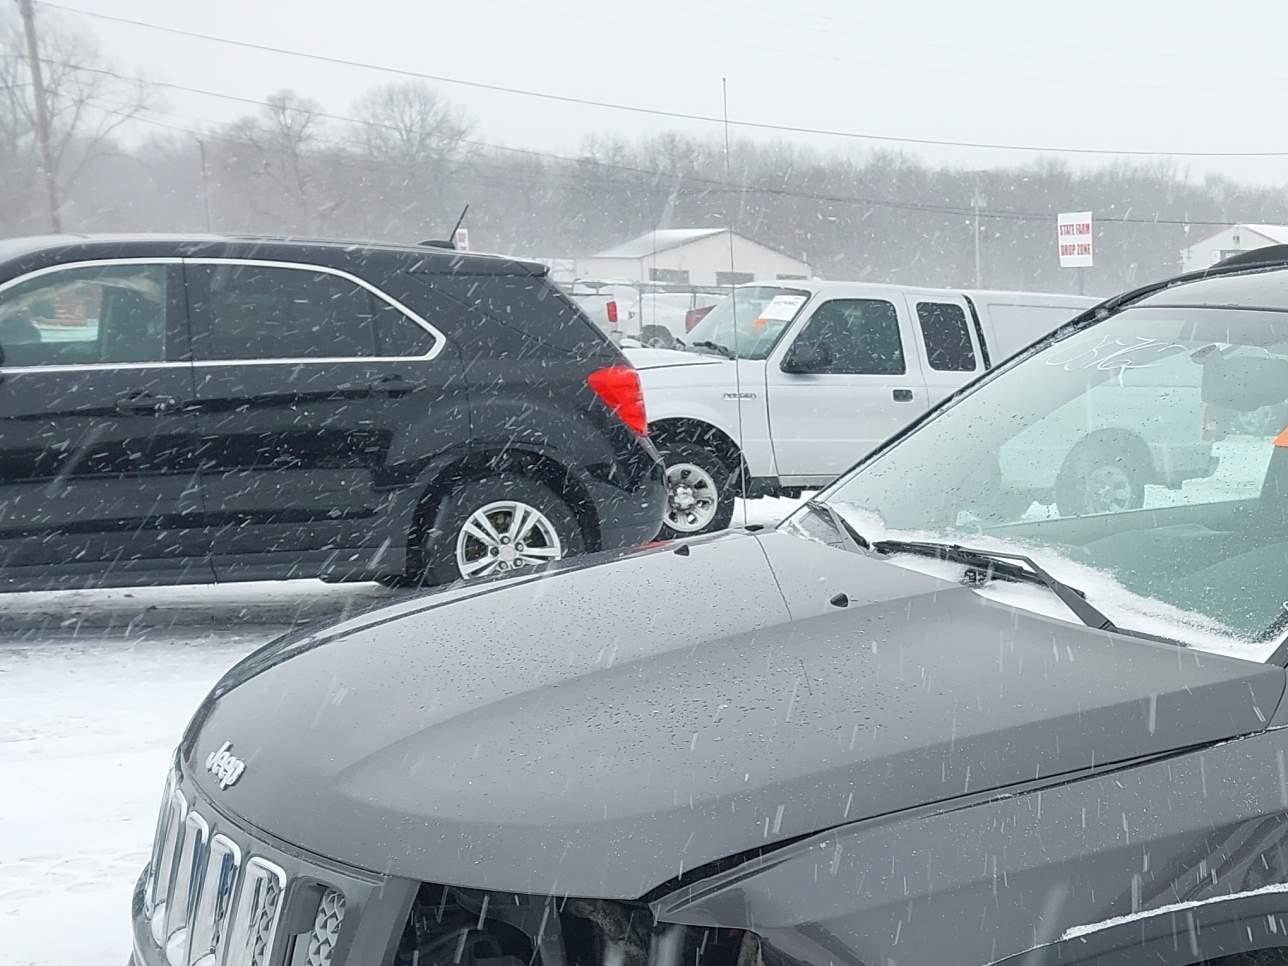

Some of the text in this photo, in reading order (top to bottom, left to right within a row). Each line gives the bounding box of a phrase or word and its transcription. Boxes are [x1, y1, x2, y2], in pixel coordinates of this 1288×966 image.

[1060, 223, 1090, 236] STATE FARM
[1061, 243, 1091, 256] DROP ZONE
[205, 740, 246, 790] Jeep
